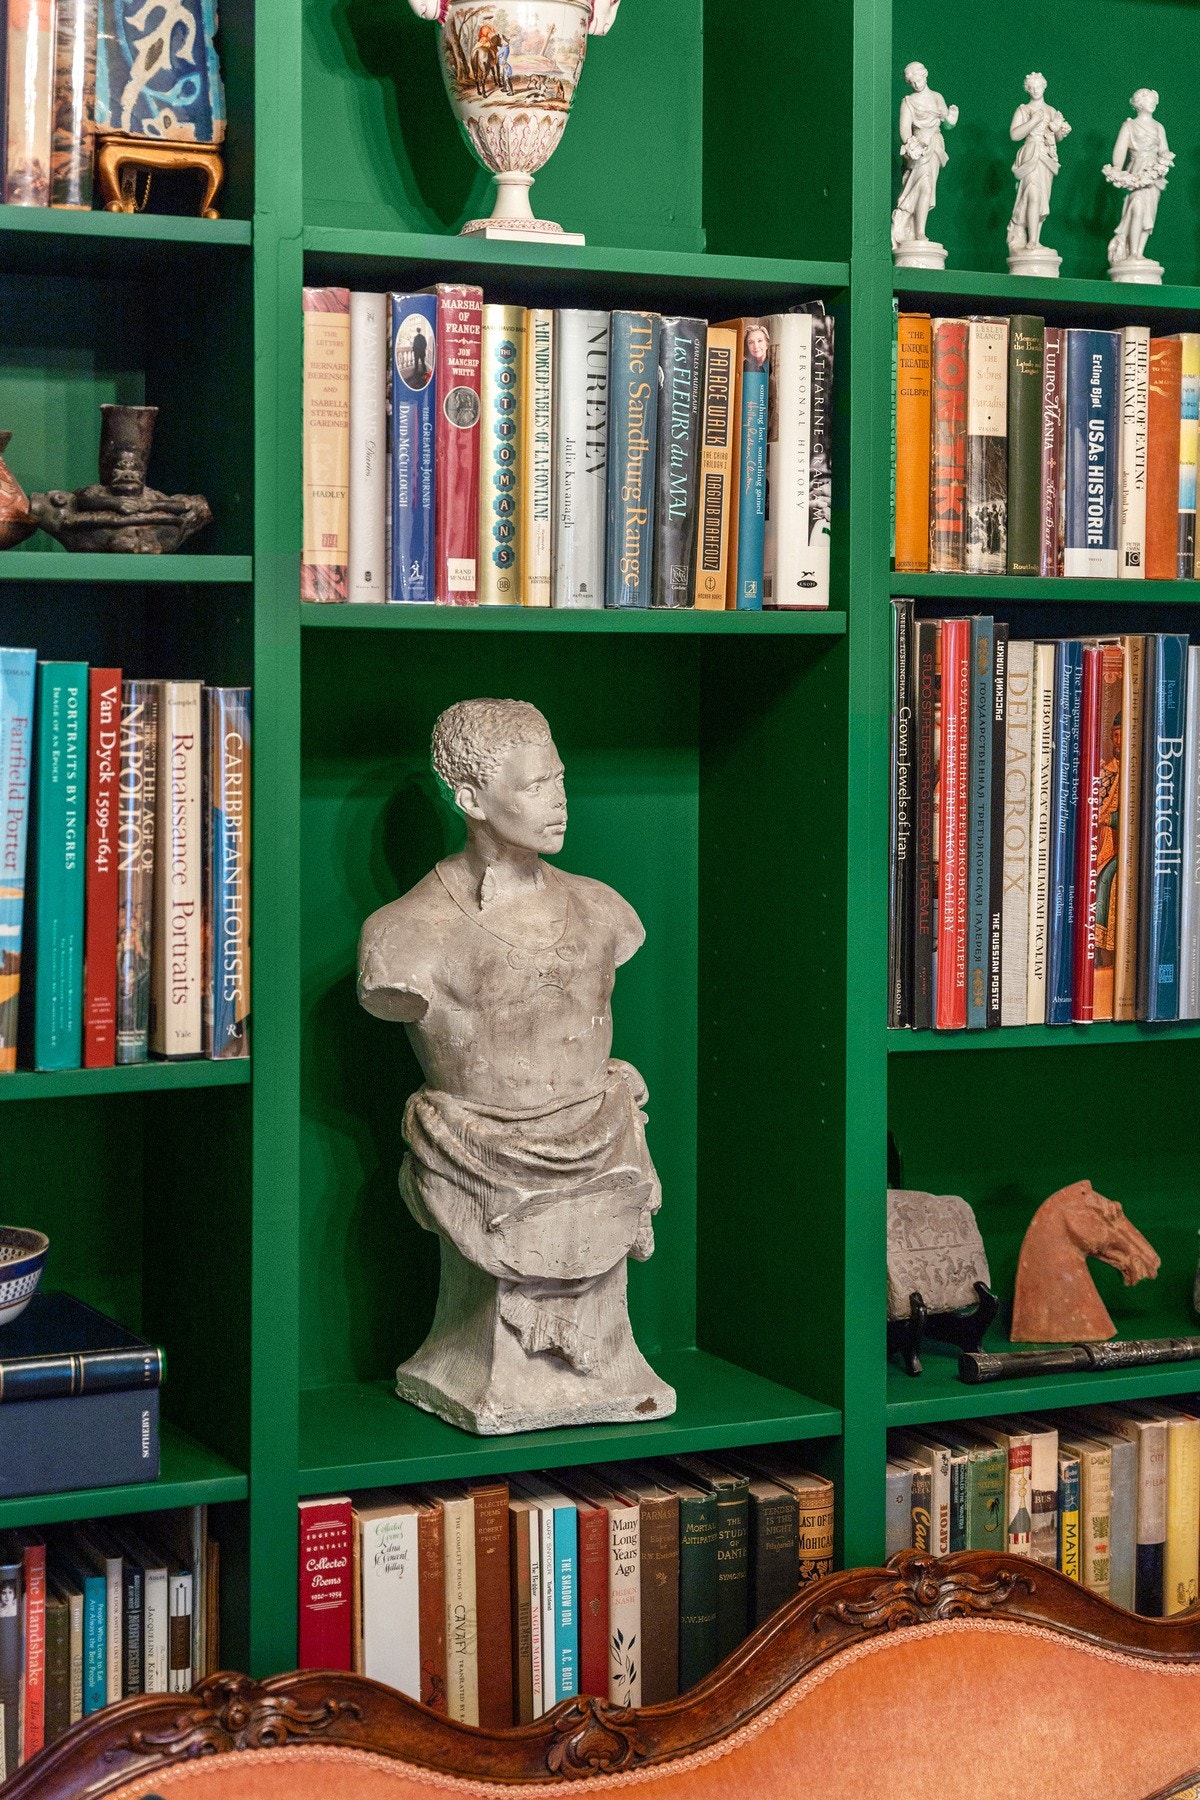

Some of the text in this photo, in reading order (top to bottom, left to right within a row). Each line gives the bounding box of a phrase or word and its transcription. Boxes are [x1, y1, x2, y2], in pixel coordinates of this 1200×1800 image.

[445, 323, 481, 334] FRANCE
[458, 312, 470, 322] OF
[976, 326, 1004, 334] LESLEY
[316, 339, 344, 347] LETTERS
[629, 316, 653, 374] The
[908, 331, 925, 340] THE
[976, 333, 1004, 341] BLANCH
[311, 362, 349, 370] BERNARD
[447, 358, 480, 367] MANCHIP
[457, 348, 471, 356] JON
[899, 358, 930, 369] TREATIES
[983, 355, 997, 363] THE
[308, 371, 350, 381] BERENSON
[452, 367, 475, 377] WHITE
[1090, 354, 1103, 385] Erling
[1124, 341, 1136, 425] IN FRANCE
[311, 399, 348, 408] ISABELLA
[585, 323, 608, 482] NUREYEV
[706, 349, 729, 446] PALACE WALK
[757, 384, 765, 425] something
[900, 388, 929, 397] GILBERT
[1090, 387, 1103, 408] Bjøl
[311, 409, 348, 418] STEWART
[668, 336, 693, 522] Les FLEURS du MAL
[796, 345, 807, 509] PERSONAL HISTORY
[811, 335, 826, 521] KATHARINE GRAHAM
[935, 322, 967, 532] KON-TIKI
[1135, 339, 1148, 490] THE ART OF EATING
[621, 382, 651, 501] Sandburg
[1088, 419, 1105, 461] USAs
[421, 406, 432, 509] THE GREATER JOURNEY
[755, 446, 763, 487] something
[312, 490, 346, 499] HADLEY
[561, 437, 576, 529] Julie Kavanagh
[1045, 478, 1056, 546] Mike Dash
[1087, 465, 1104, 545] HISTORIE
[703, 475, 722, 570] NAGUIB MAHFOUZ
[619, 507, 647, 588] Range
[920, 653, 932, 697] STUDIO
[995, 640, 1005, 721] РУССКИЙ ПЛАКАТ
[99, 686, 118, 724] Van
[1167, 679, 1177, 709] Ronald
[1069, 664, 1083, 806] The Language of the Body
[96, 730, 116, 784] Dyck
[4, 716, 29, 871] Fairfield Porter
[65, 687, 78, 870] PORTRAITS BY INGRES
[118, 702, 145, 873] NAPOLEON
[1004, 672, 1029, 893] DELACROIX
[141, 763, 155, 874] THE AGE OF
[224, 732, 243, 885] CARIBBEAN
[1154, 735, 1184, 876] Botticelli
[919, 802, 931, 862] DEBORAH
[944, 715, 957, 933] THE STATE TRETYAKOV GALLERY
[956, 659, 969, 988] ГОСУДАРСТВЕННАЯ ТРЕТЬЯКОВСКАЯ ГАЛЕРЕЯ
[974, 682, 987, 963] ГОСУДАРСТВЕННАЯ ТРЕТЬЯКОВСКАЯ ГАЛЕРЕЯ
[171, 732, 195, 1005] Renaissance Portraits
[919, 866, 931, 935] TURBEVILLE
[1057, 885, 1065, 917] Gordon
[1163, 886, 1172, 904] Life
[223, 895, 243, 1002] HOUSES
[992, 932, 1000, 972] RUSSIAN
[991, 975, 999, 1010] POSTER
[175, 1030, 192, 1038] Yale
[480, 1509, 501, 1518] POEMS
[486, 1518, 495, 1526] OF
[612, 1519, 638, 1532] Many
[726, 1517, 742, 1526] THE
[762, 1505, 797, 1516] TENDER
[306, 1529, 347, 1540] EUGENIO
[478, 1525, 503, 1535] ROBERT
[480, 1534, 502, 1544] FROST
[612, 1533, 638, 1546] Long
[685, 1522, 717, 1533] MORTAL
[718, 1527, 748, 1540] STUDY
[729, 1539, 740, 1547] OF
[766, 1523, 793, 1536] NIGHT
[939, 1503, 949, 1554] CAPOTE
[306, 1541, 347, 1553] MONTALE
[612, 1548, 638, 1561] Years
[717, 1548, 748, 1561] DANTE
[1066, 1523, 1079, 1577] MAN'S
[306, 1557, 347, 1572] Collected
[614, 1563, 636, 1577] Ago
[311, 1574, 342, 1588] Poems
[612, 1586, 637, 1597] OGDEN
[615, 1595, 635, 1606] NASH
[28, 1566, 45, 1686] The Handshake
[88, 1613, 96, 1636] Always
[561, 1558, 573, 1692] THE SHADOW IDOL A.C. BOLER
[88, 1650, 96, 1665] Best
[128, 1614, 140, 1685] NORWEGIAN
[88, 1666, 96, 1688] People
